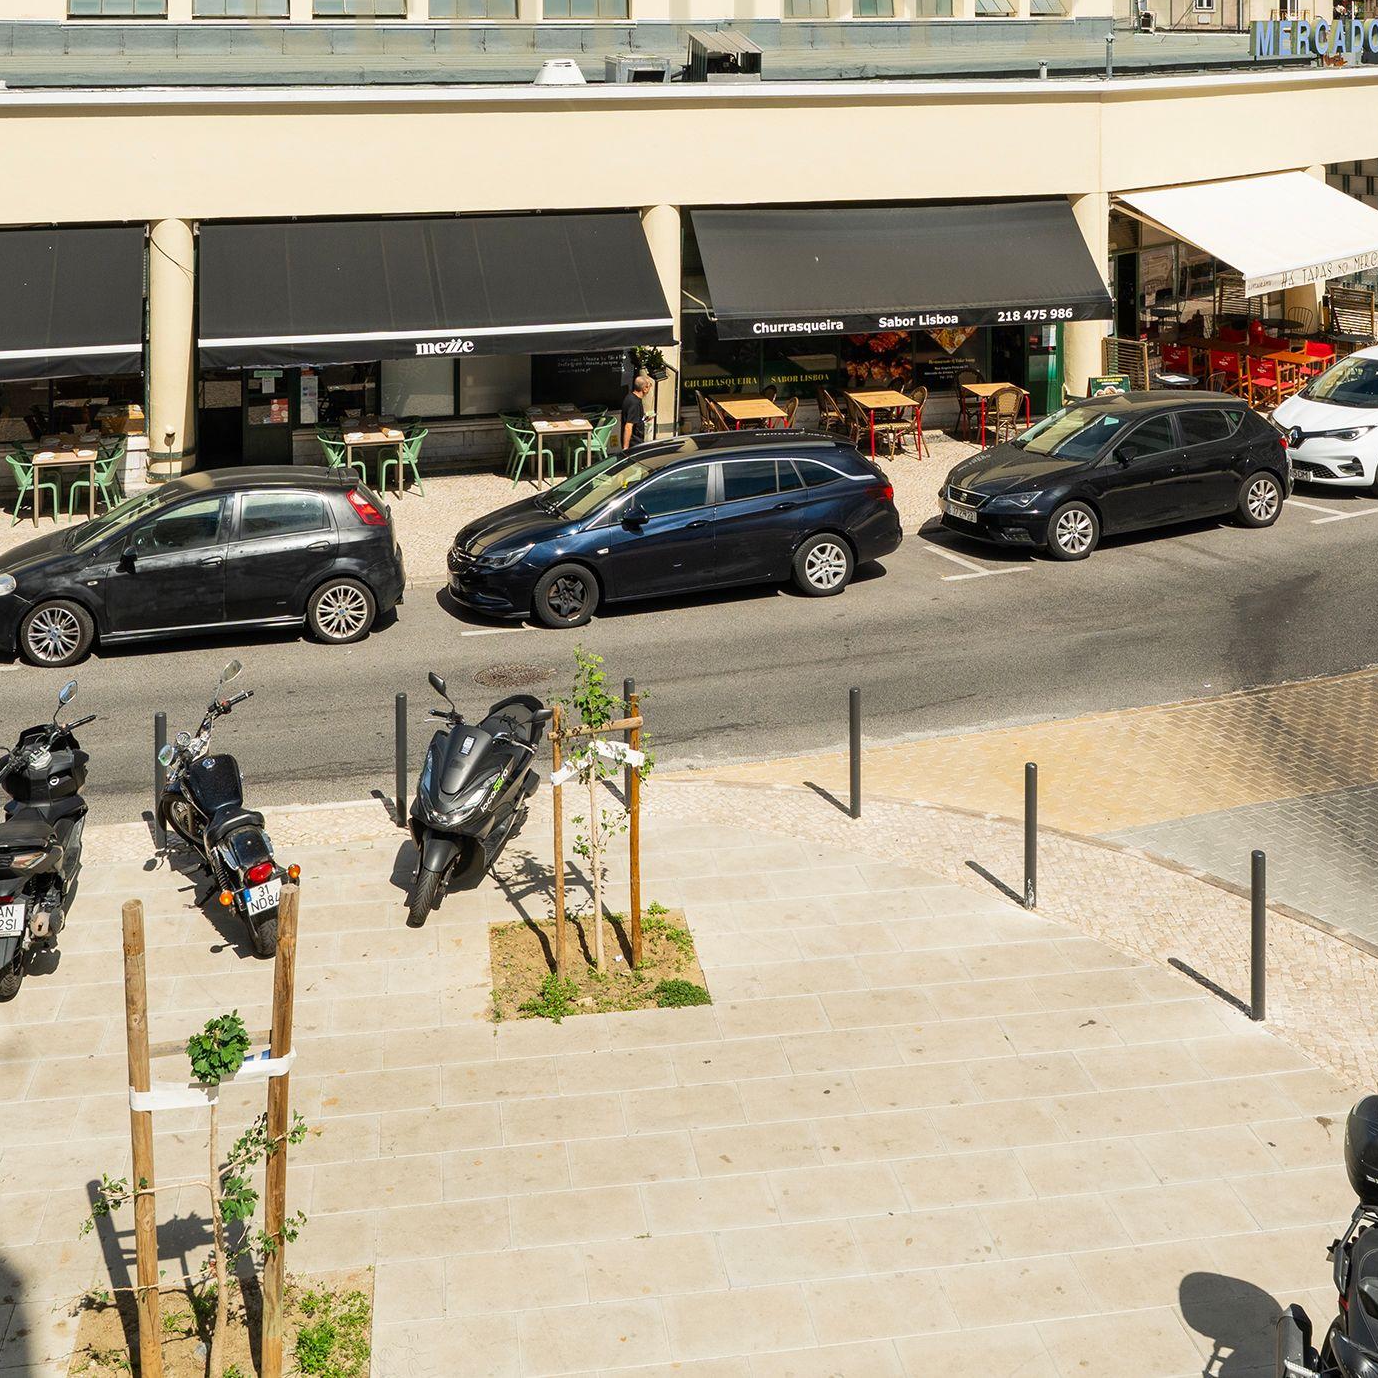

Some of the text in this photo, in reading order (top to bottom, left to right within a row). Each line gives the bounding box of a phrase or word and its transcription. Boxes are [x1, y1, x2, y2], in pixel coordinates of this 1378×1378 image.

[753, 308, 1073, 335] Churrasqueira Sabor Lisboa 218 475 986
[684, 373, 830, 388] CHURRASQUEIRA SABOR LISBOA
[258, 884, 270, 898] 31
